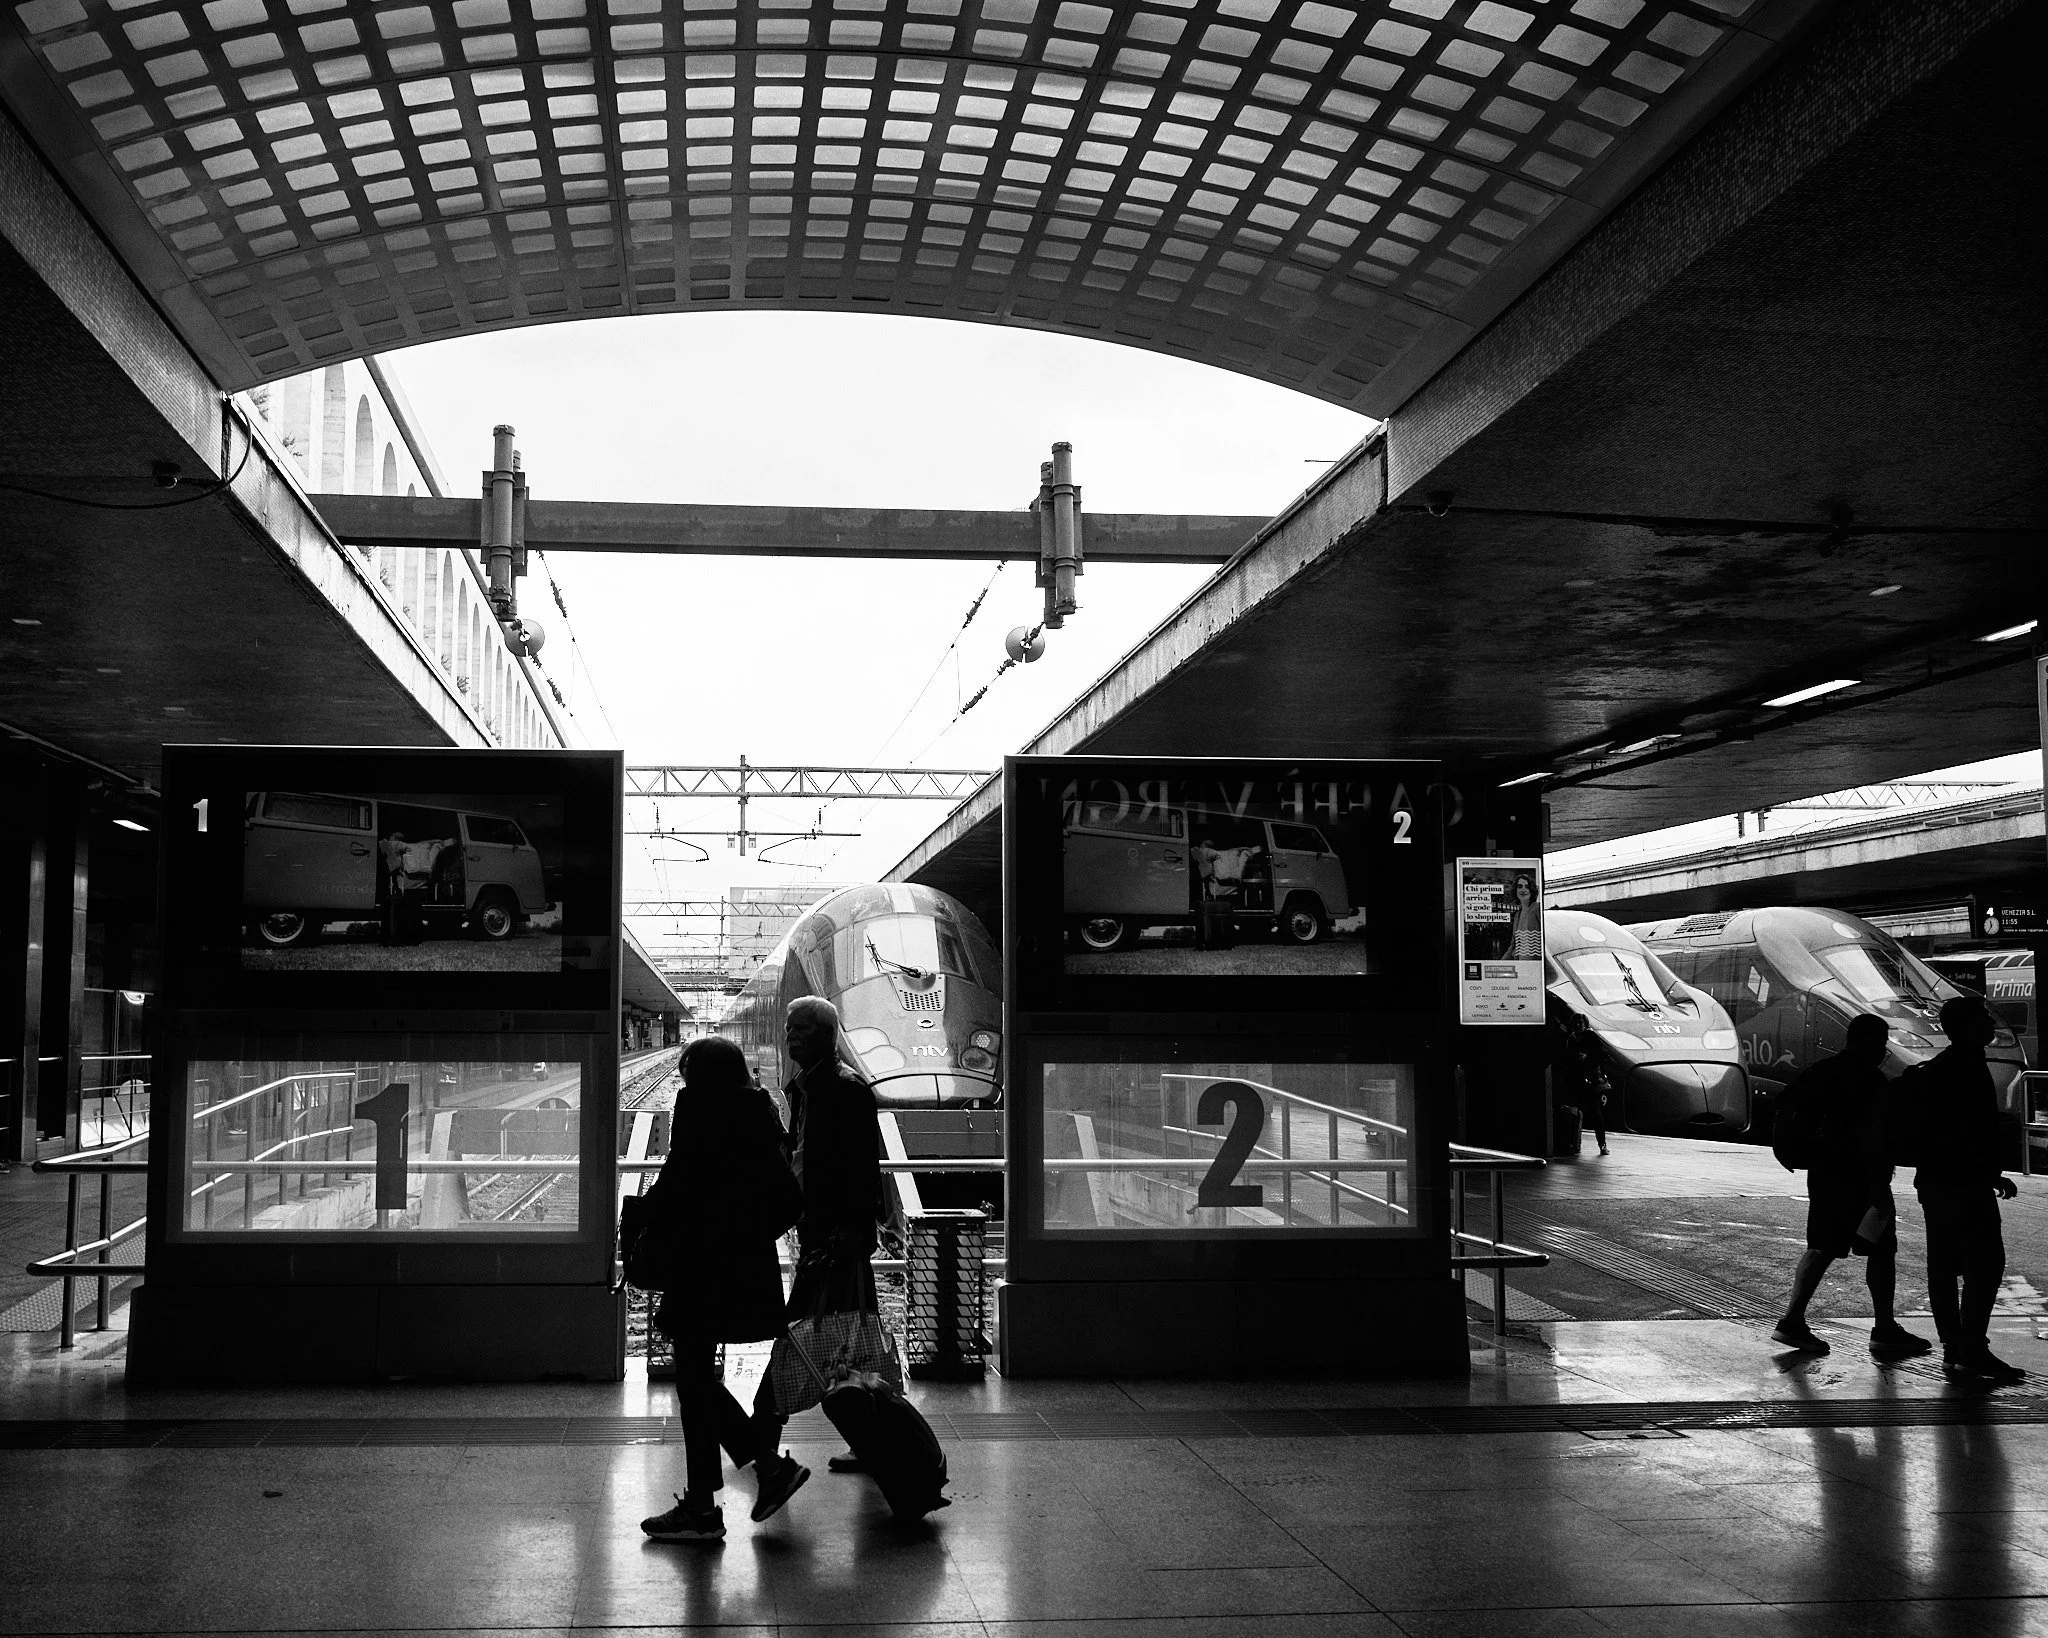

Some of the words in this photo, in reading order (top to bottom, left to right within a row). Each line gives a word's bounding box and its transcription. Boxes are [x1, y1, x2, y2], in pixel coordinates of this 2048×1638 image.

[191, 798, 209, 833] 1
[1392, 811, 1412, 844] 2
[1480, 885, 1502, 894] prima
[1473, 904, 1491, 912] gode
[1986, 906, 1994, 917] 4
[1475, 913, 1510, 922] shopping.
[1992, 978, 2034, 998] Prima
[1652, 1023, 1681, 1034] ntv
[910, 1044, 949, 1057] ntv
[1601, 1094, 1608, 1106] 9
[355, 1083, 410, 1210] 1
[1197, 1082, 1265, 1208] 2
